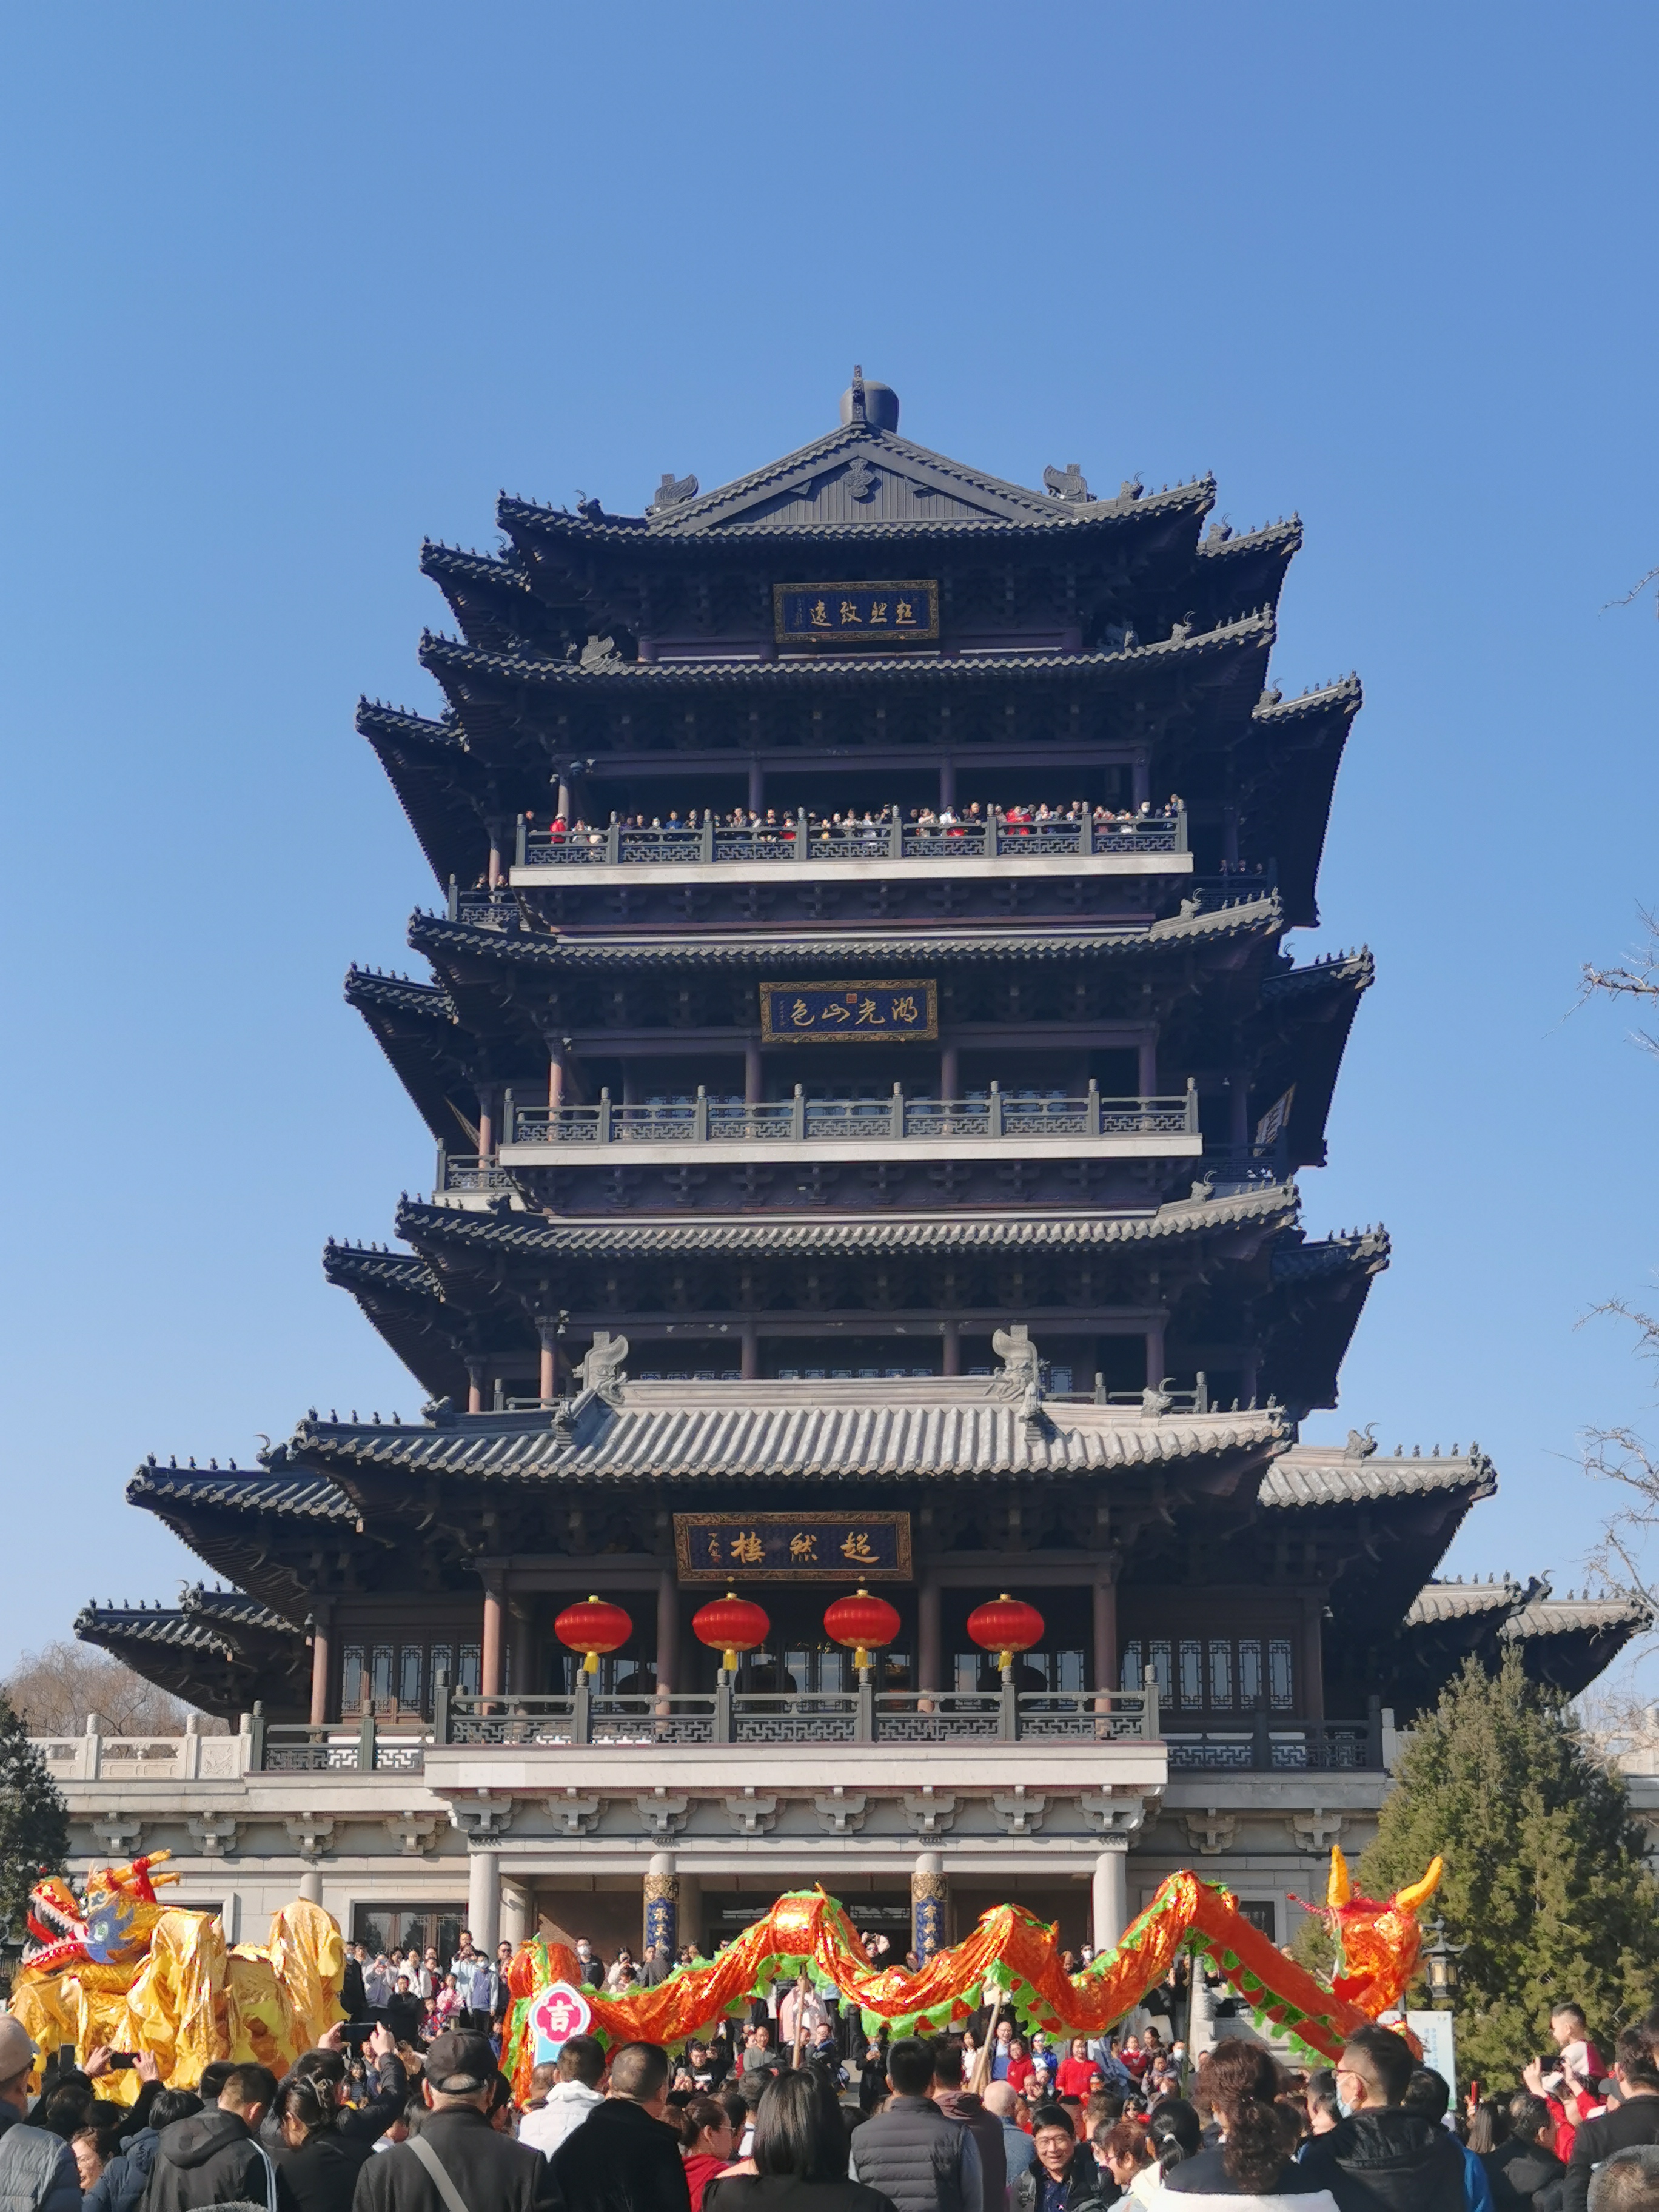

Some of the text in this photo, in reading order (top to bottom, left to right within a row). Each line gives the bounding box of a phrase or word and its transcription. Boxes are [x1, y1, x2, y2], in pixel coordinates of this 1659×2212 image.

[790, 996, 919, 1027] 湖光山色
[730, 1532, 880, 1564] 超然樓
[546, 2000, 575, 2032] 吉
